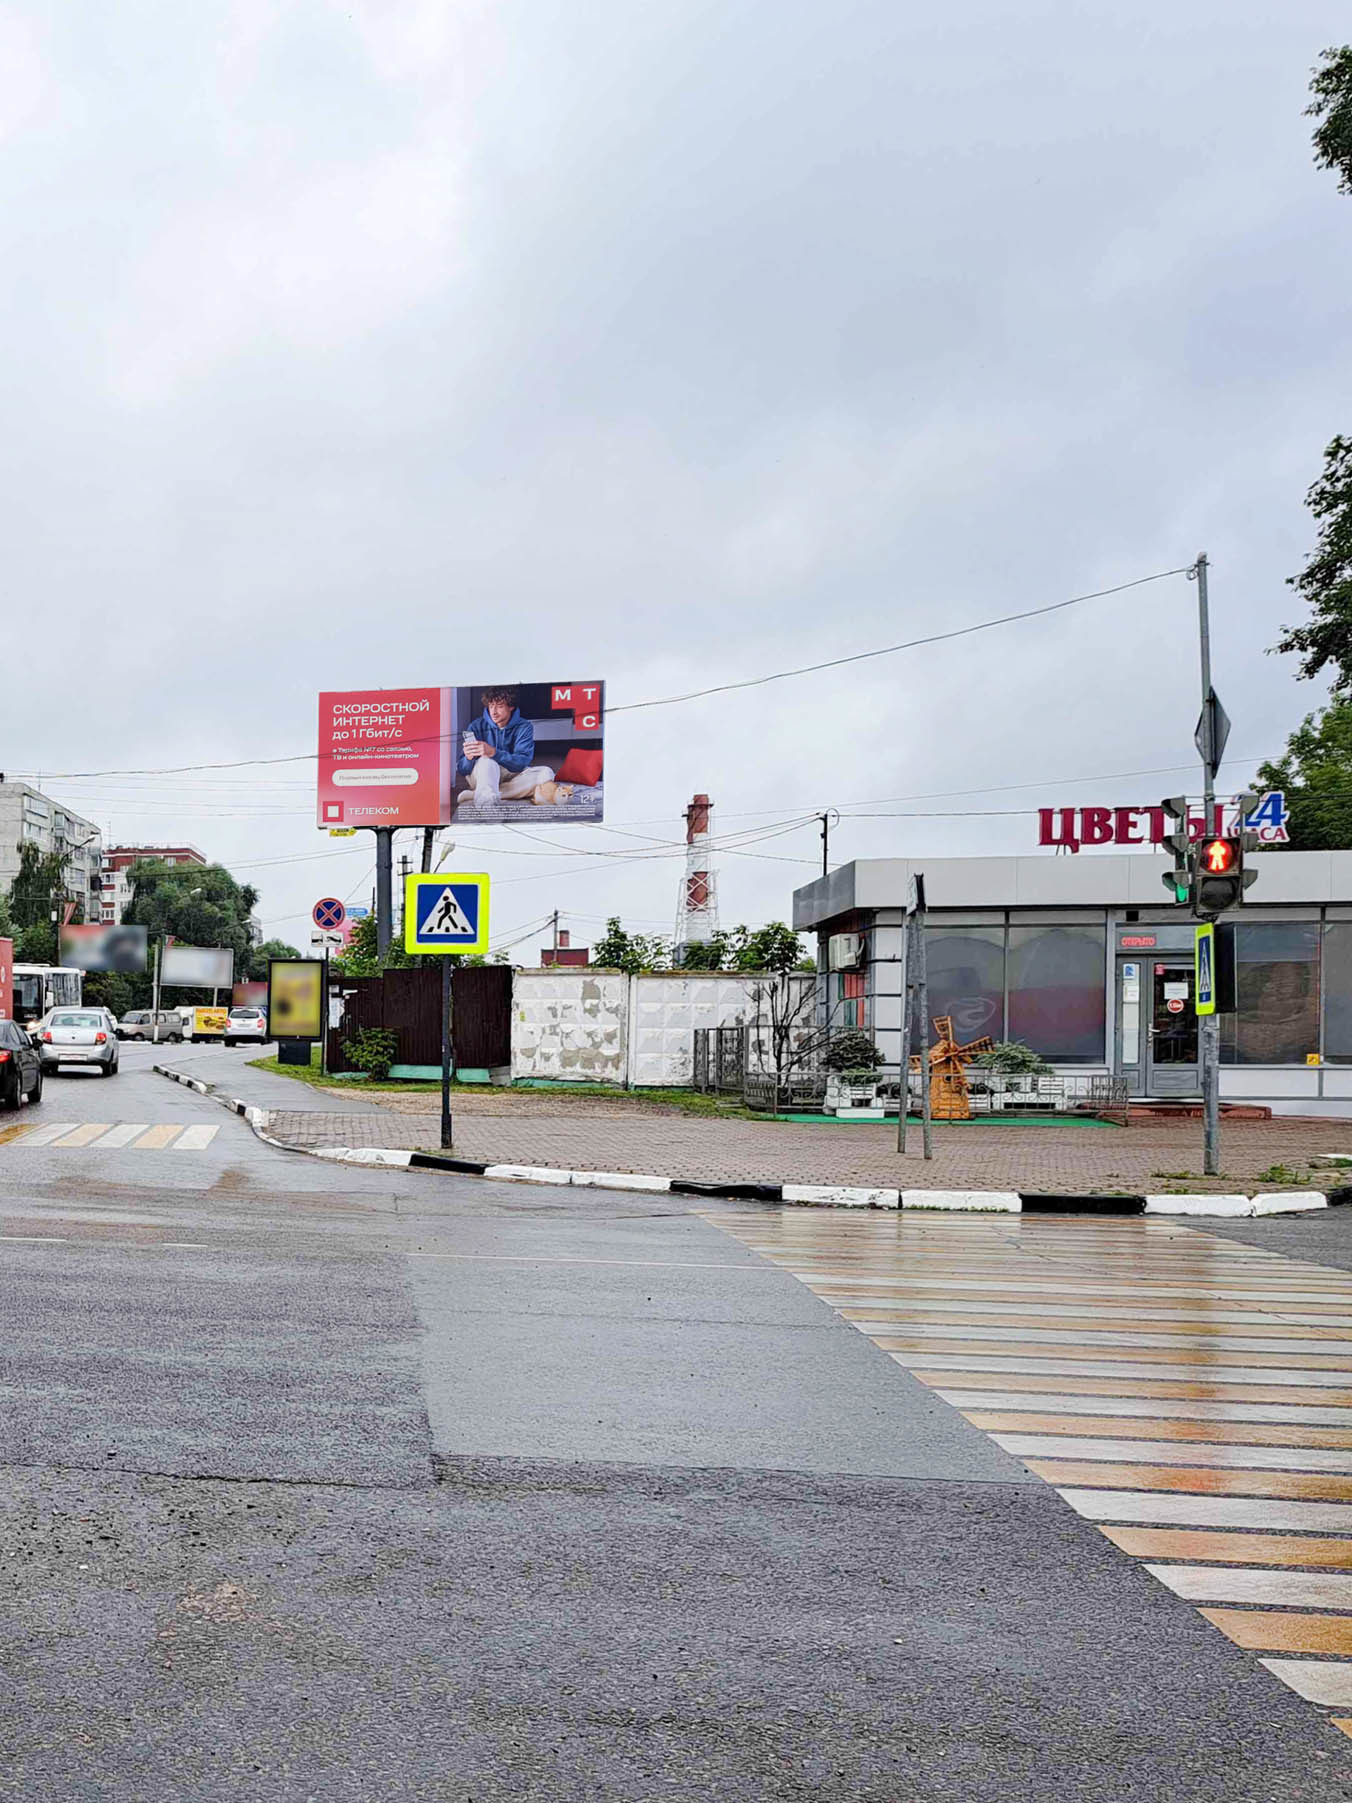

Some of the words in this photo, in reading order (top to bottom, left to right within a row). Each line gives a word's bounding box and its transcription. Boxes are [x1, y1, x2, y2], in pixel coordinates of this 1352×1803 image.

[332, 699, 430, 715] СКОРОСТНОЙ
[332, 714, 405, 727] ИНТЕРНЕТ
[332, 729, 350, 741] до
[351, 729, 357, 739] 1
[359, 727, 403, 739] Гбит/с
[348, 807, 400, 816] ТЕЛЕКОМ
